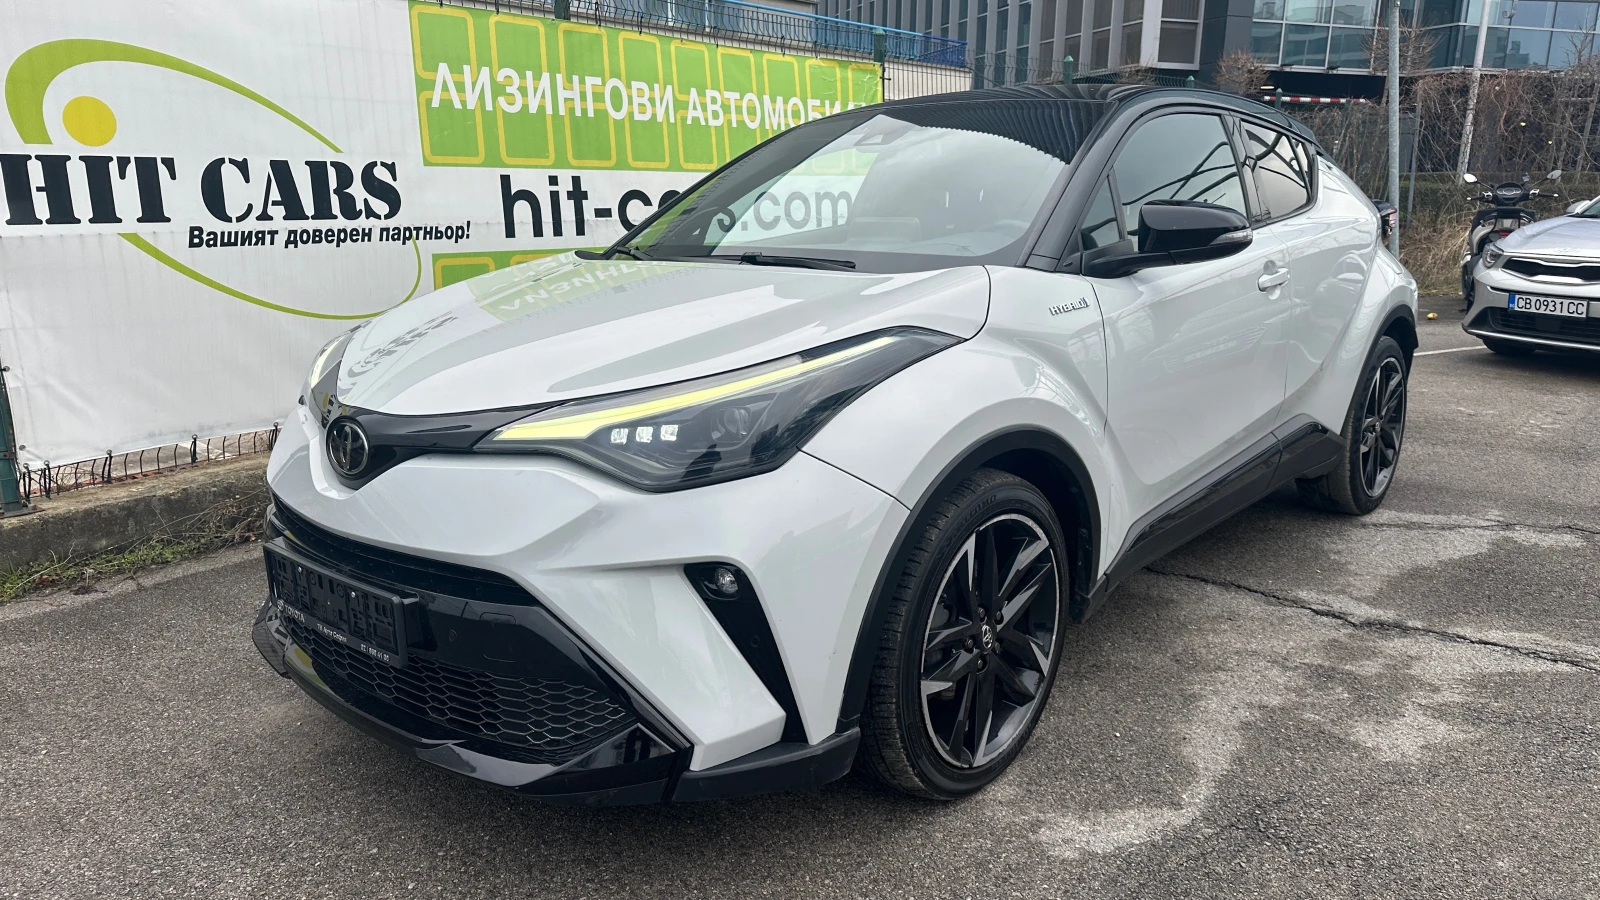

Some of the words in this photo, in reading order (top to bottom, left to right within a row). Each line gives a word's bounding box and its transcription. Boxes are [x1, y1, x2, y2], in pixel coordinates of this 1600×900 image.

[431, 62, 676, 123] ЛИЗИНГОВИ
[686, 87, 872, 131] АВТОМОБИ
[0, 153, 177, 226] HIT
[200, 157, 402, 224] CARS
[188, 225, 279, 249] Вашият
[284, 226, 373, 249] доверен
[378, 221, 472, 246] партньор!
[1049, 299, 1085, 316] HYBRID
[1516, 296, 1532, 310] CB
[1534, 298, 1564, 314] 0931
[1567, 301, 1585, 316] CC
[285, 604, 306, 623] TOYOTA
